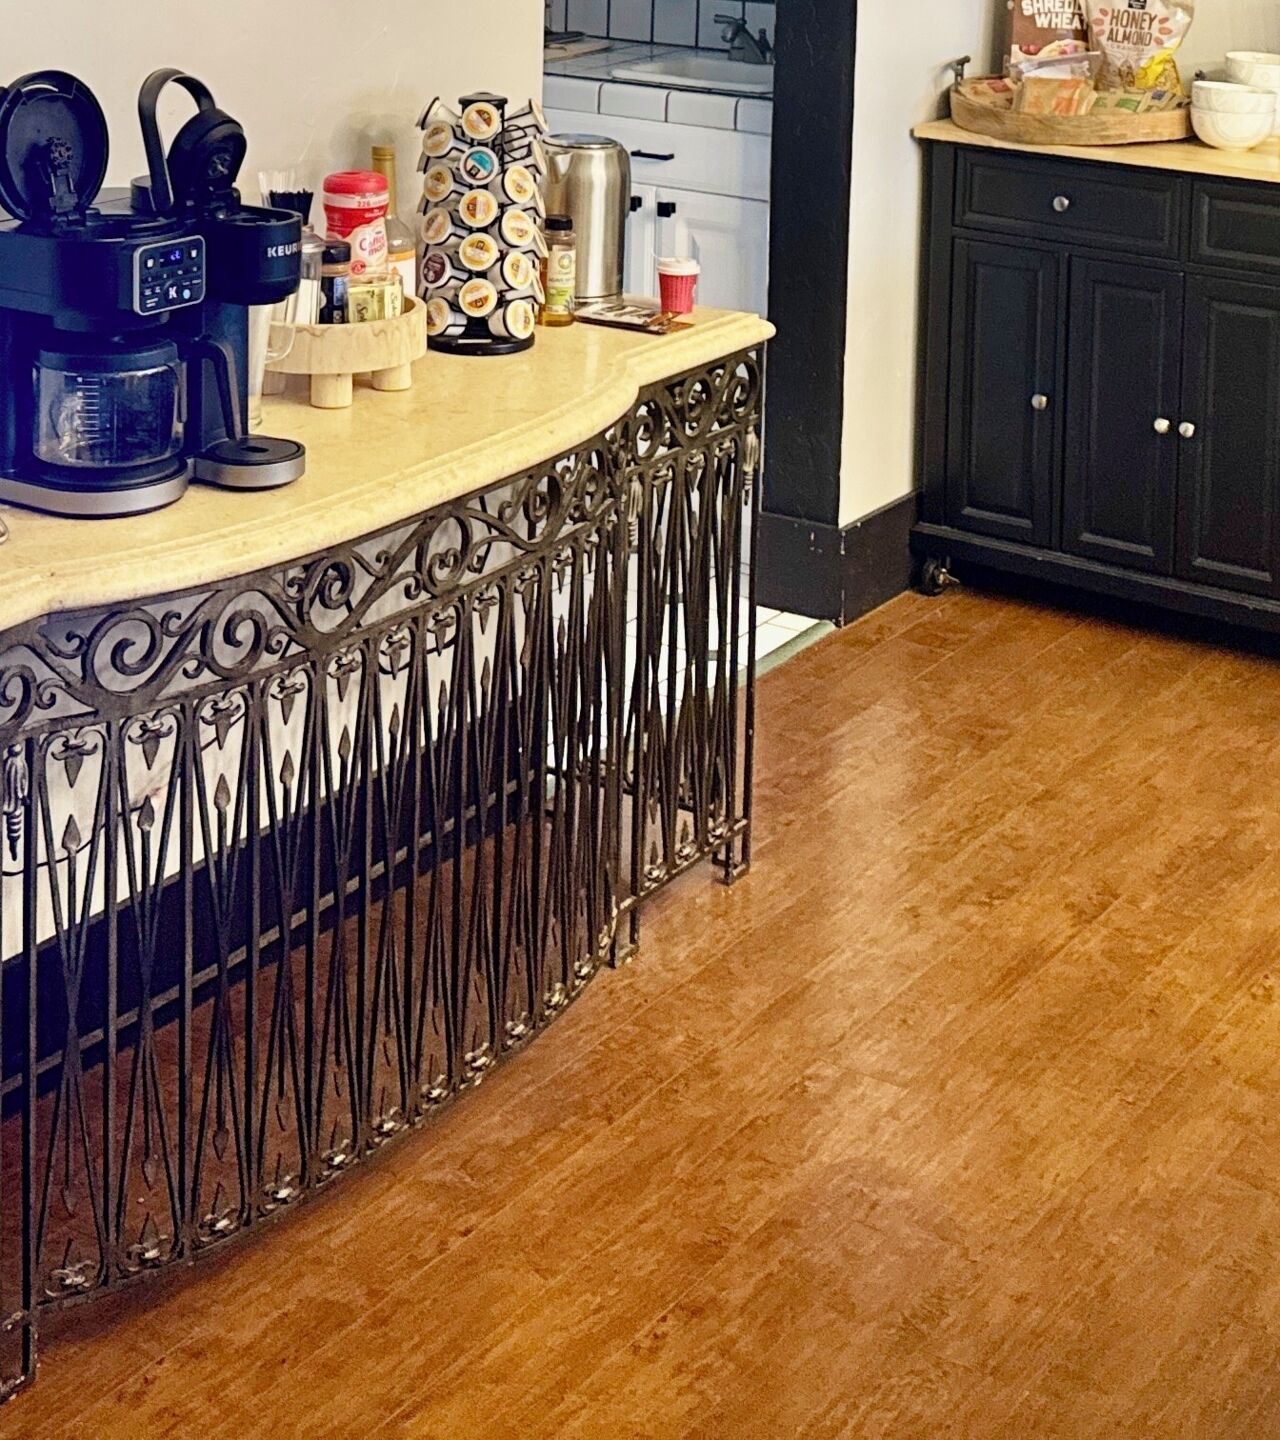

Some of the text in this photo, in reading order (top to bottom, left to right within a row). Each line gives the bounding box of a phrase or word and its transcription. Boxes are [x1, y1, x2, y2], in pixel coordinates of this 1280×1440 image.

[1109, 8, 1157, 32] HONEY
[1106, 29, 1153, 47] ALMOND
[267, 242, 300, 258] KEUR
[168, 285, 178, 300] K
